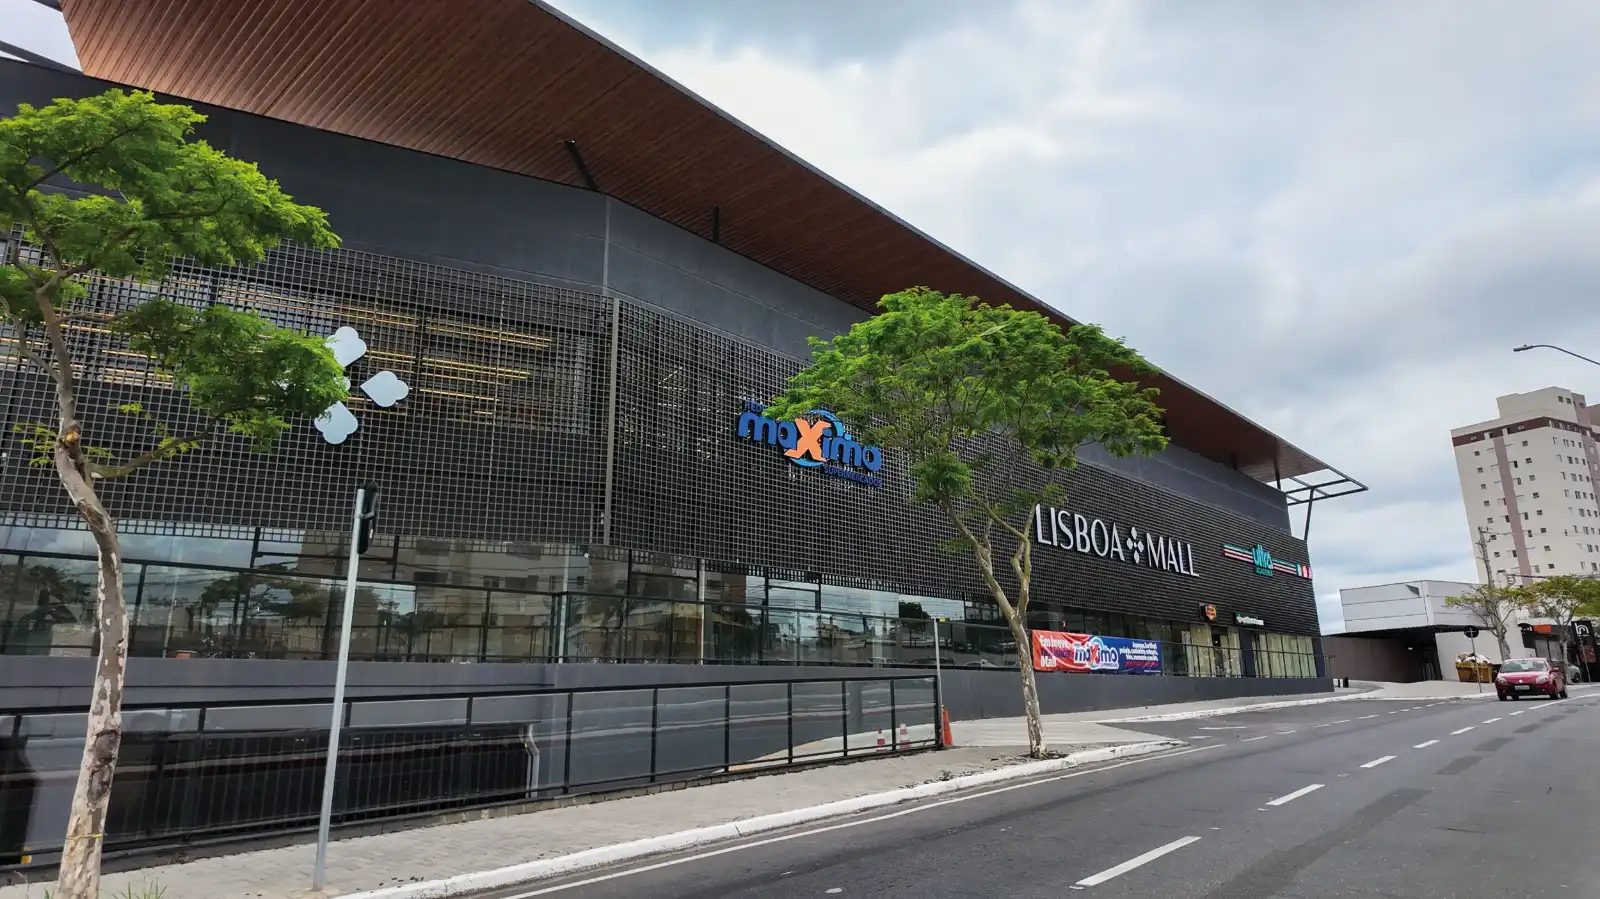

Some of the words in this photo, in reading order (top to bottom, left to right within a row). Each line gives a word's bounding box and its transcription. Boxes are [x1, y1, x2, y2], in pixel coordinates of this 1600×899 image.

[824, 465, 883, 488] SUPERMERCADOS
[1035, 503, 1126, 562] LISBOA
[1146, 532, 1200, 577] MALL
[1040, 634, 1050, 647] Em
[1040, 655, 1057, 667] Mall
